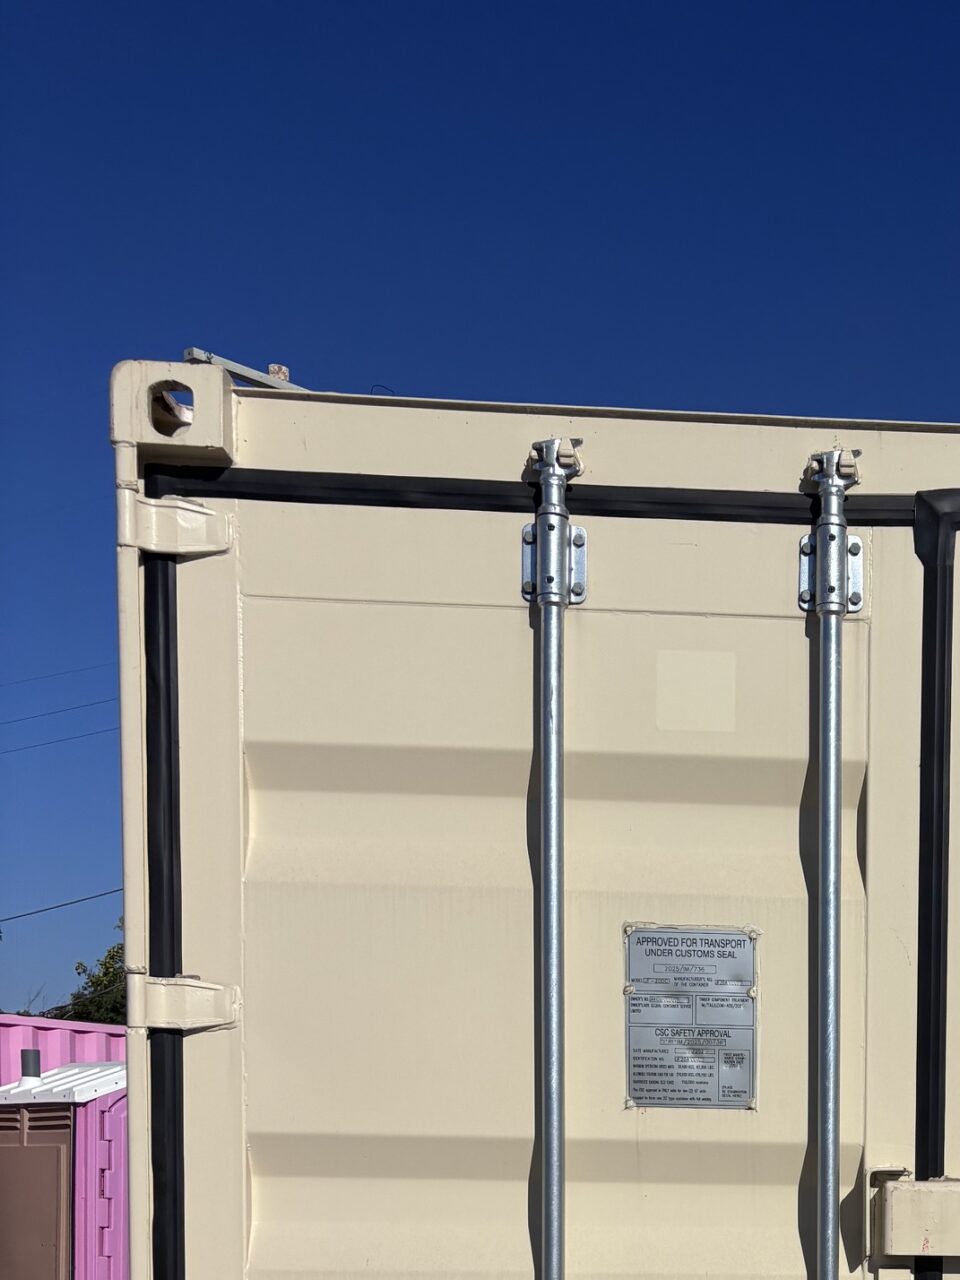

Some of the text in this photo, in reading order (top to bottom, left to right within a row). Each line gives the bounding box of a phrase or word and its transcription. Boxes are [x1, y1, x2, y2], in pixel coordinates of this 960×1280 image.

[636, 936, 747, 949] APPROVED FOR TRANSPORT
[644, 948, 738, 959] UNDER CUSTOMS SEAL
[655, 1028, 732, 1038] CSC SAFETY APPROVAL
